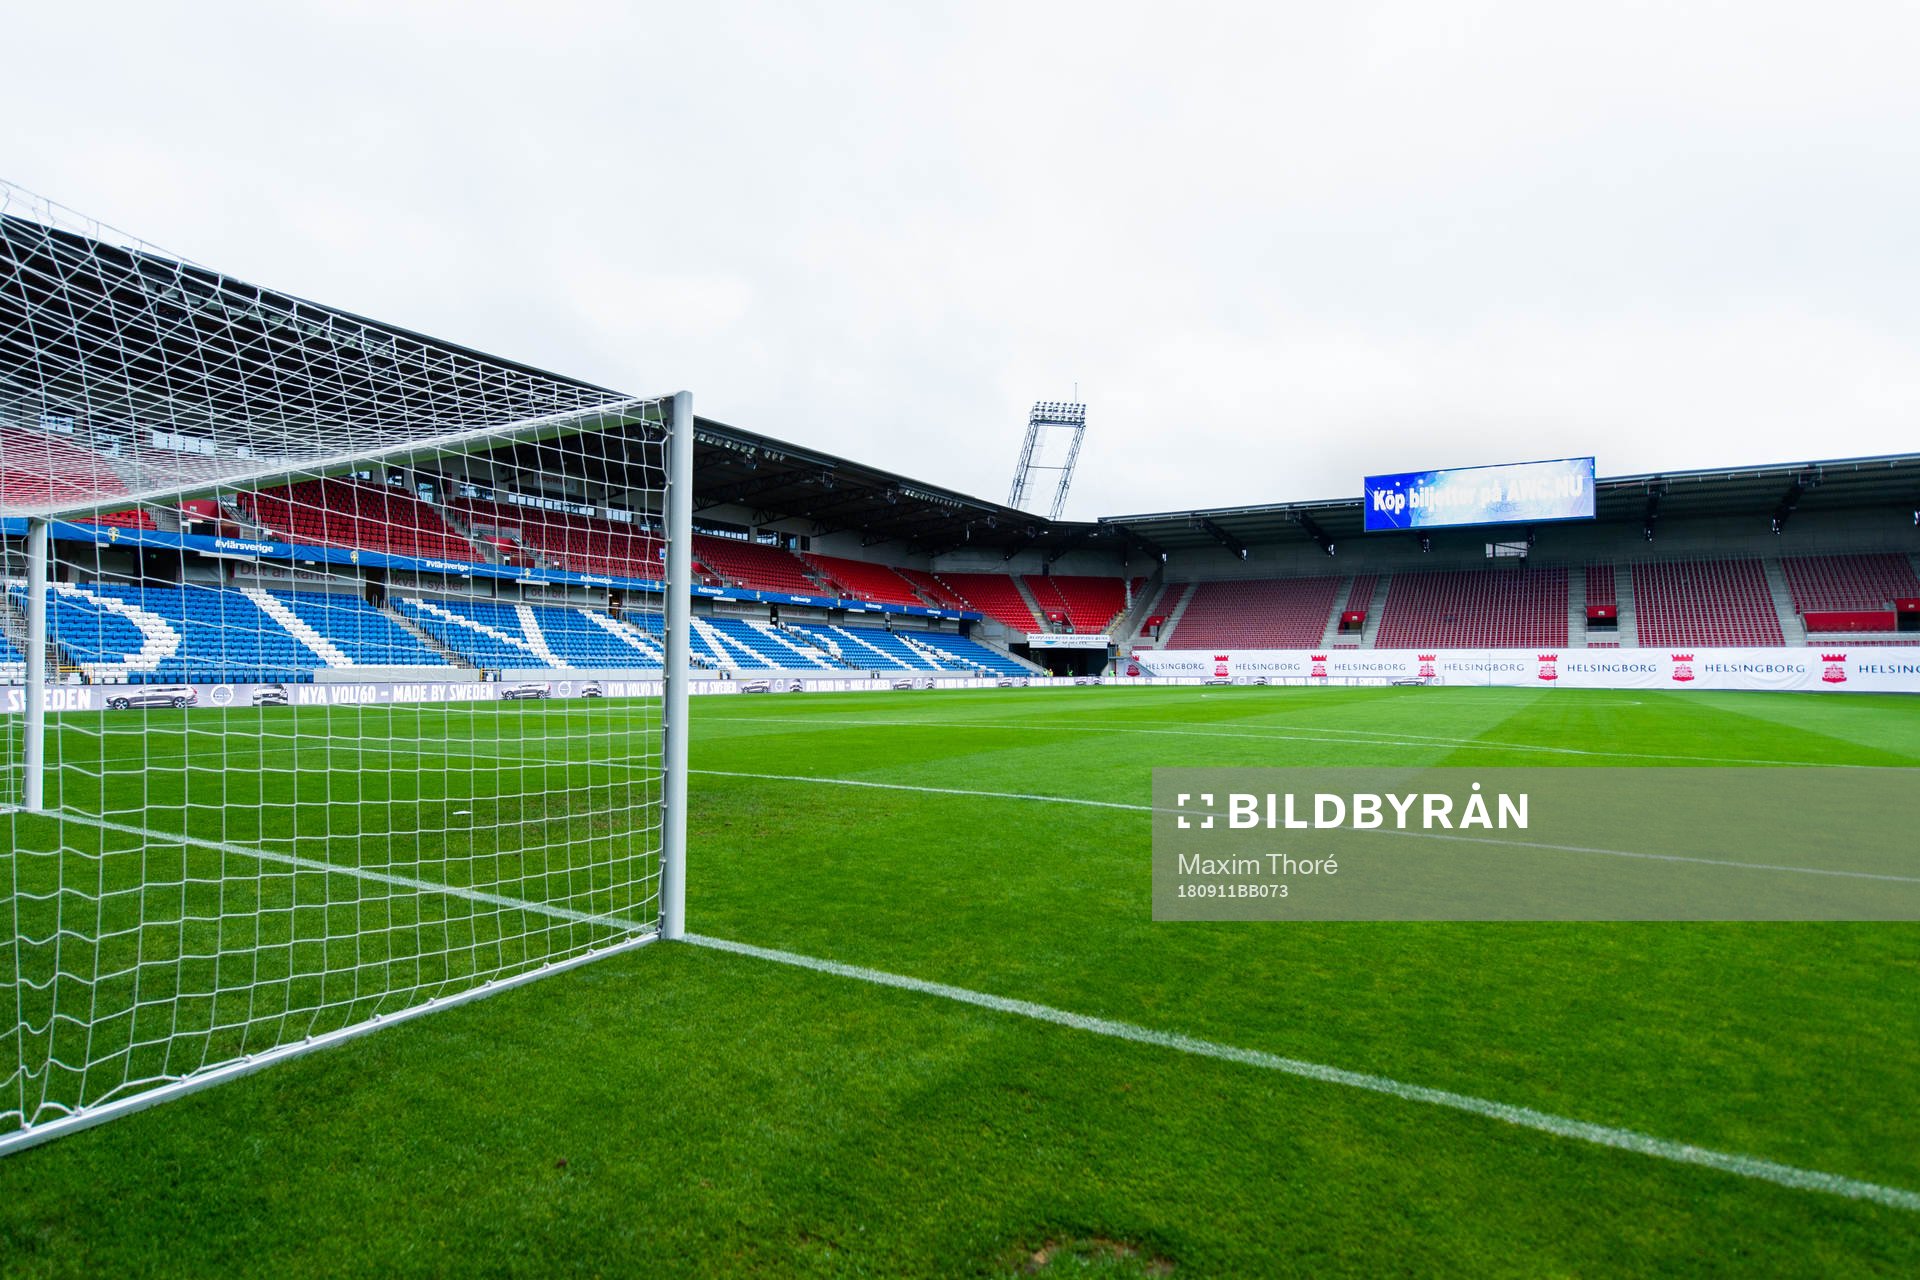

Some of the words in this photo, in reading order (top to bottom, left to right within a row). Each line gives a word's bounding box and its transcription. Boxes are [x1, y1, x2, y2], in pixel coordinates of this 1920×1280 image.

[1373, 489, 1405, 515] Köp
[214, 538, 274, 554] #viärsverige
[1235, 663, 1301, 671] HELSINGBORG
[1334, 663, 1407, 671] HELSINGBORG
[1444, 663, 1525, 672] HELSINGBORG
[1567, 664, 1657, 673] HELSINGBORG
[1704, 664, 1806, 673] HELSINGBORG
[299, 685, 328, 704] NYA
[393, 685, 427, 702] MADE
[431, 684, 446, 702] BY
[449, 683, 494, 701] SWEDEN
[7, 688, 91, 711] SEDEN
